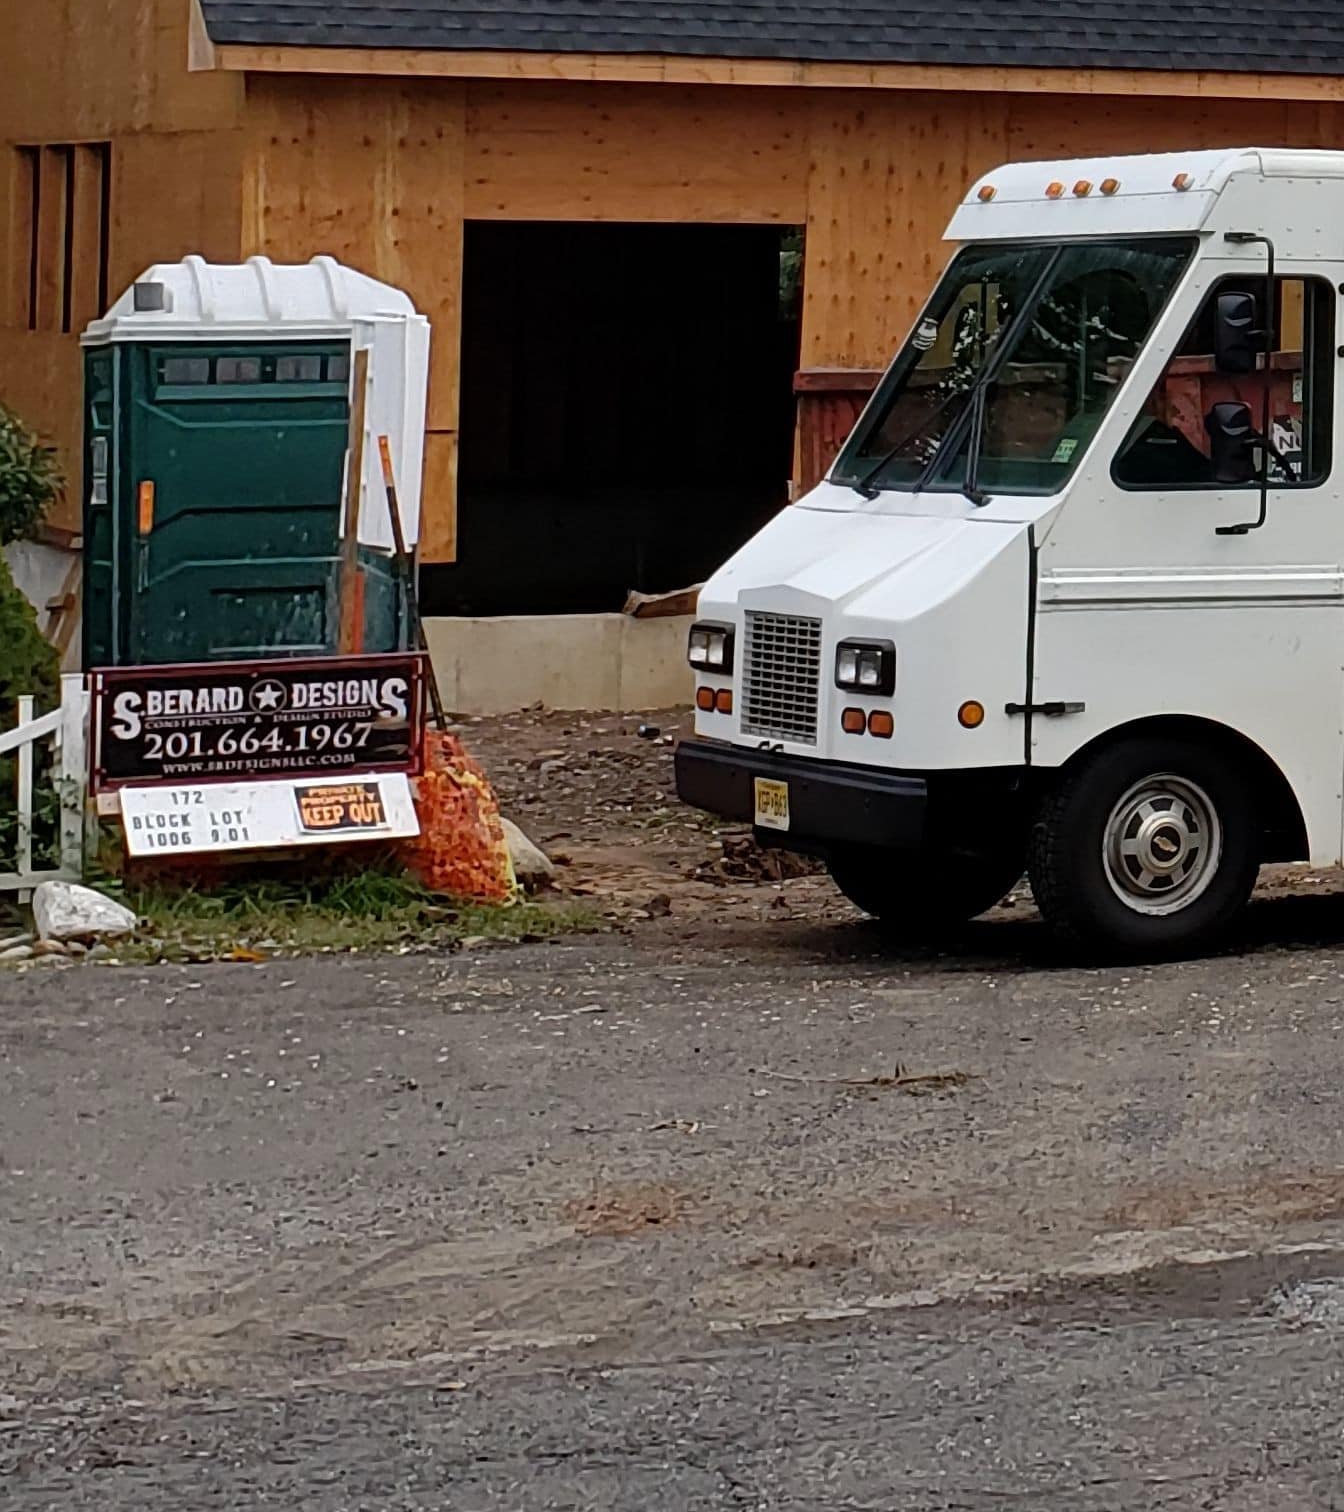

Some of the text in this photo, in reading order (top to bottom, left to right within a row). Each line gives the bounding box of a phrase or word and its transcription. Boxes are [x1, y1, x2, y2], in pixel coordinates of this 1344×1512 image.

[291, 677, 408, 720] DESIGNS
[143, 721, 373, 759] 201.664.1967
[171, 791, 204, 805] 172
[132, 810, 243, 829] BLOCK LOT
[302, 802, 380, 826] KEEP OUT
